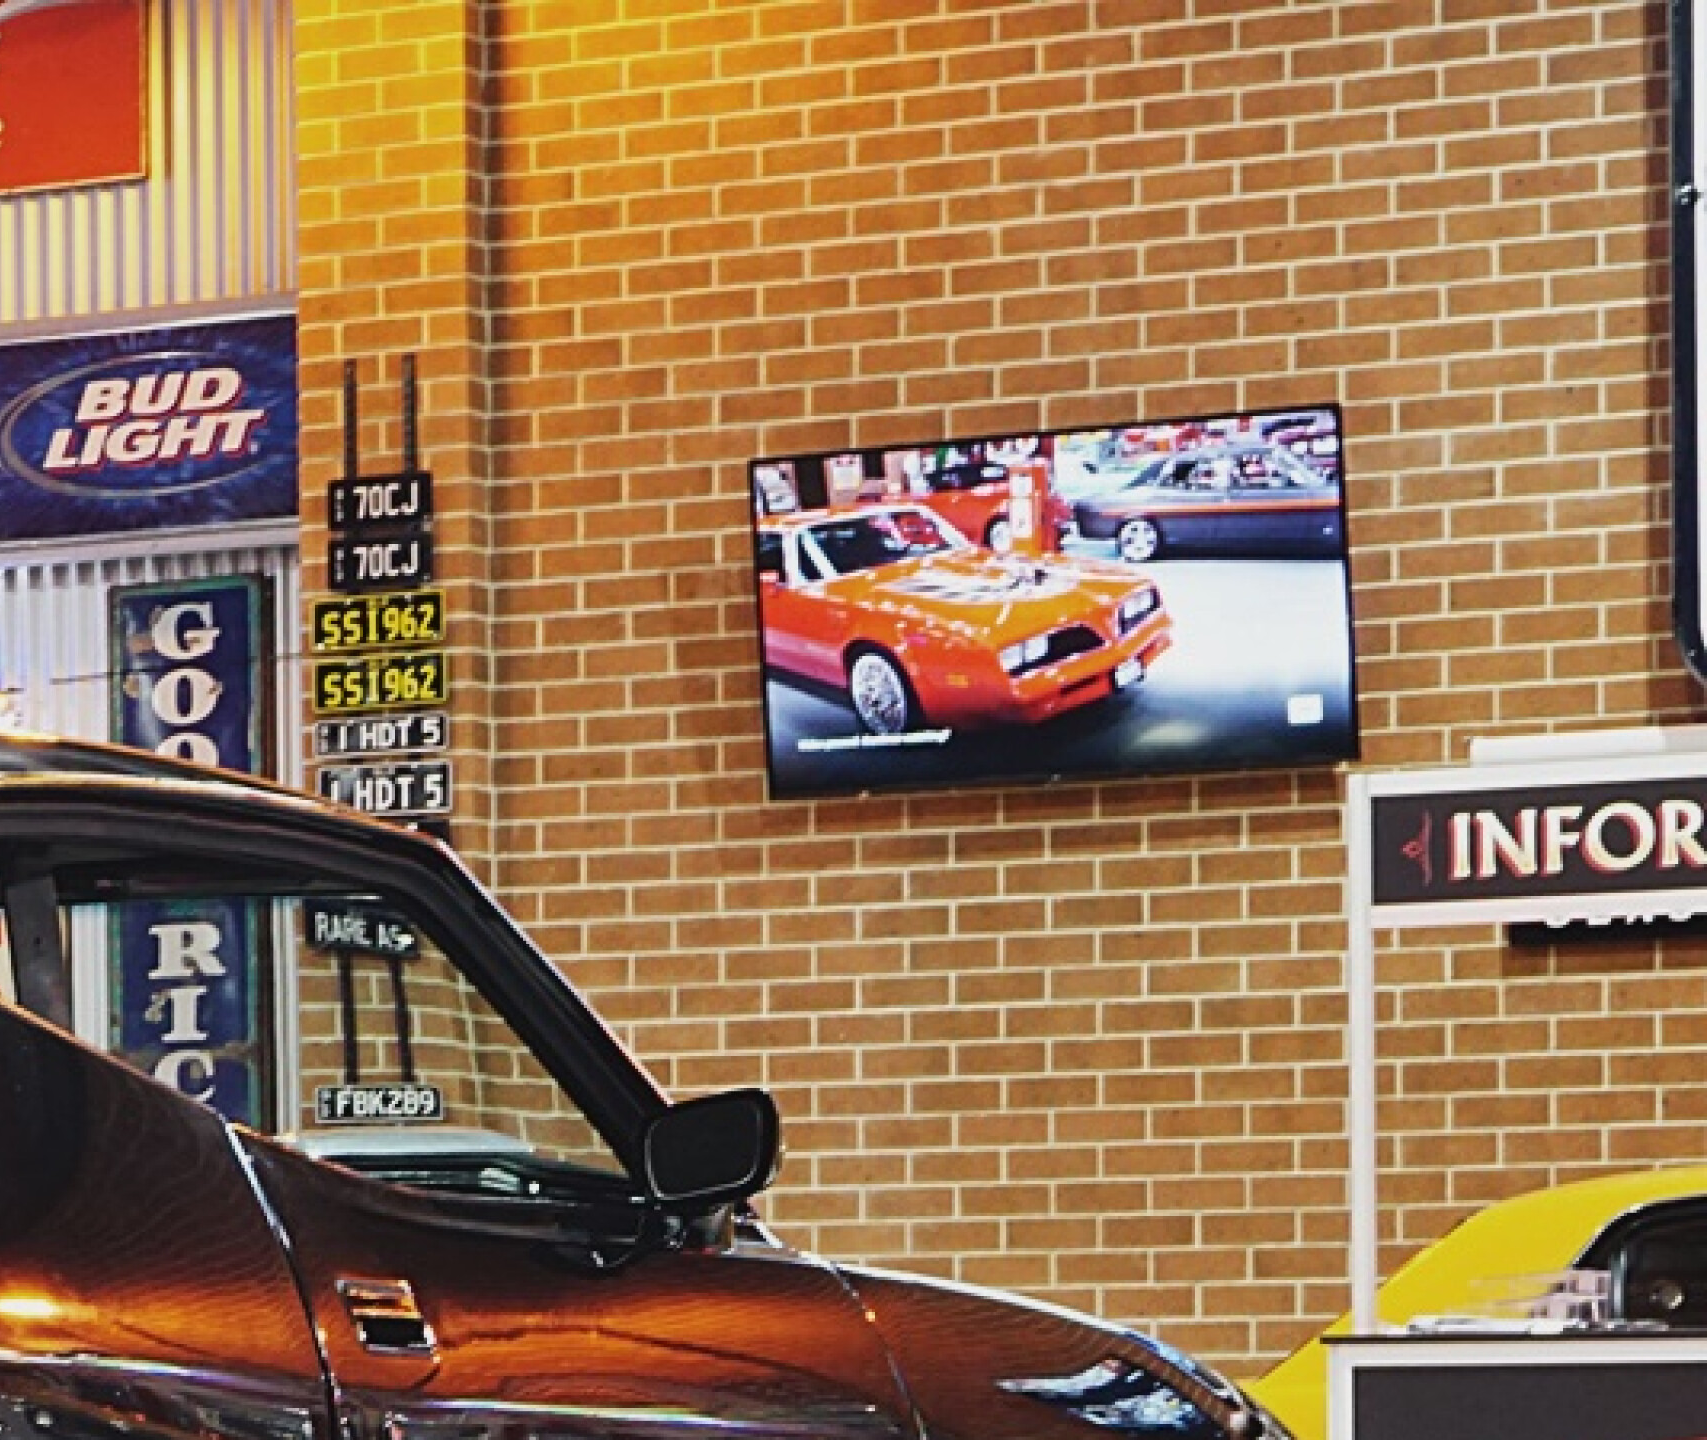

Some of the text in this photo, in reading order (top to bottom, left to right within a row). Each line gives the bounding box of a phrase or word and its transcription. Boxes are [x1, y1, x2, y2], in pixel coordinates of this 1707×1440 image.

[75, 368, 243, 424] BUD
[43, 409, 268, 475] LIGHT
[352, 480, 419, 520] 70CJ
[352, 540, 419, 580] 70CJ
[424, 773, 444, 808] 5
